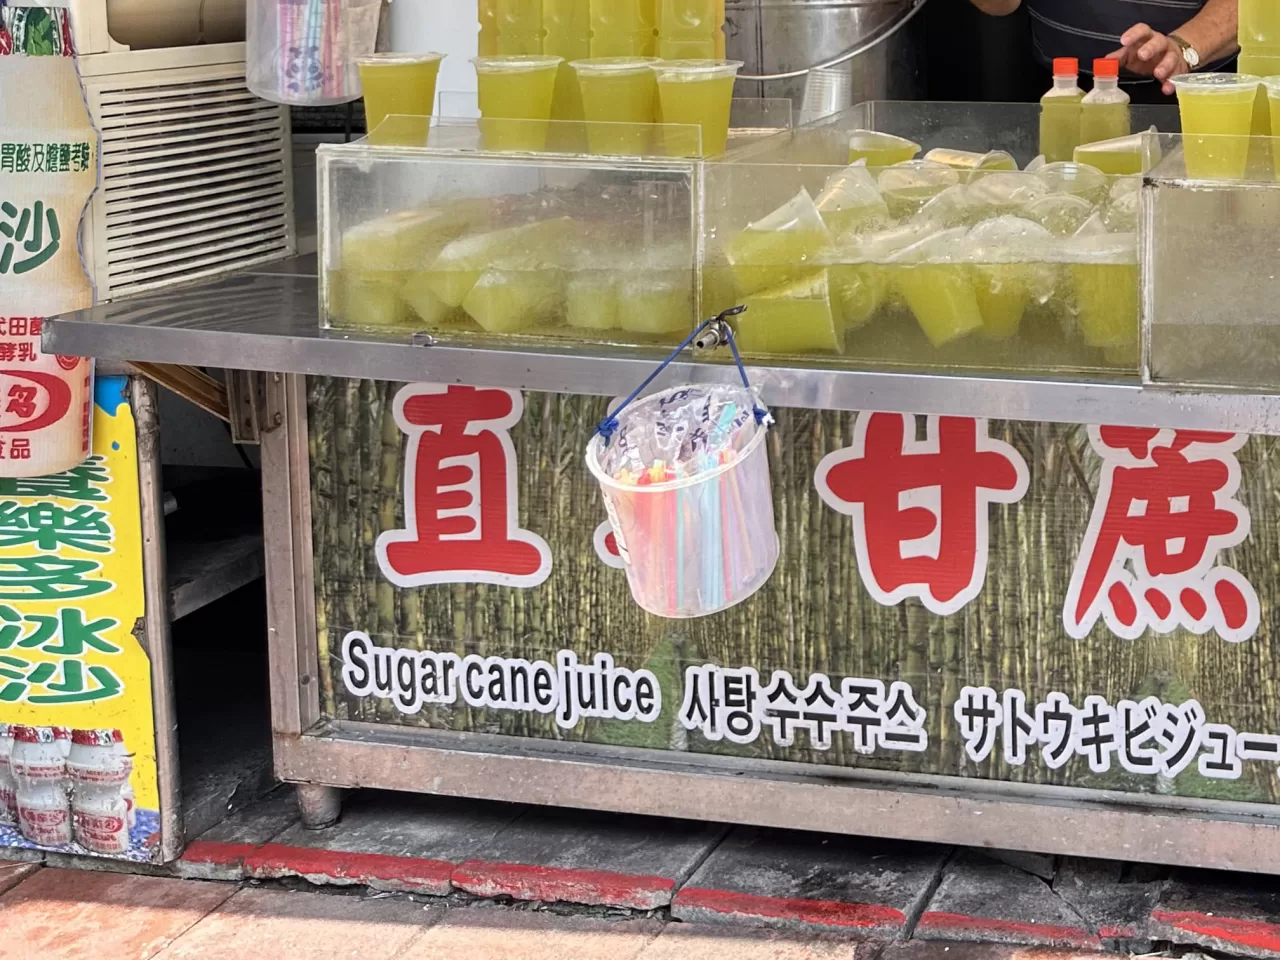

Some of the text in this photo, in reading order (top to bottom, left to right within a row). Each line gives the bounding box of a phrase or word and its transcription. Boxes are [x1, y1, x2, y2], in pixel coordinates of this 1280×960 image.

[346, 635, 656, 724] Sugar cane juice
[684, 665, 925, 750] 사탕수수주스
